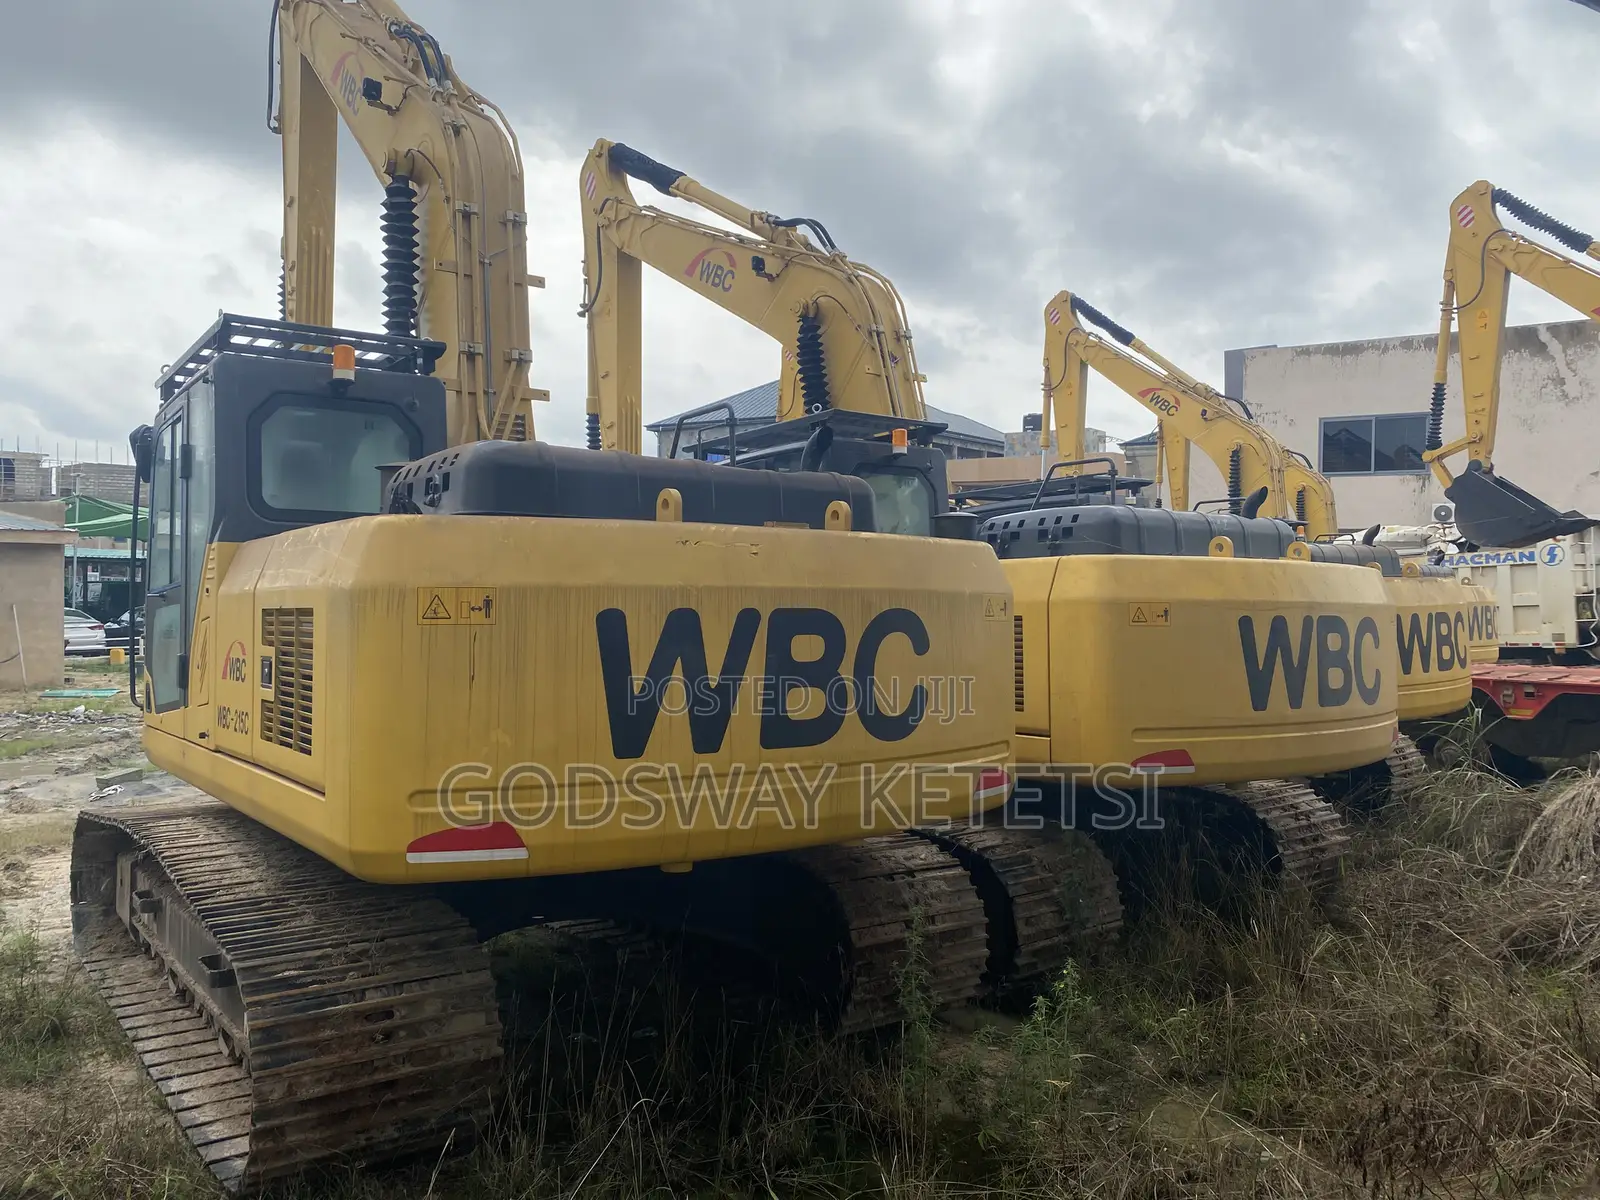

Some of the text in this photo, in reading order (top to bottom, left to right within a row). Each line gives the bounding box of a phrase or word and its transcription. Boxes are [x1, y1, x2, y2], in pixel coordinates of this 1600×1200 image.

[700, 258, 735, 292] WBC
[1149, 391, 1178, 416] WBC
[1427, 550, 1536, 567] SHACMAN
[1397, 611, 1467, 675] WBC
[229, 657, 247, 682] WBC
[1238, 614, 1381, 711] WBC
[596, 608, 930, 759] WBC
[217, 705, 249, 735] WBC-215C
